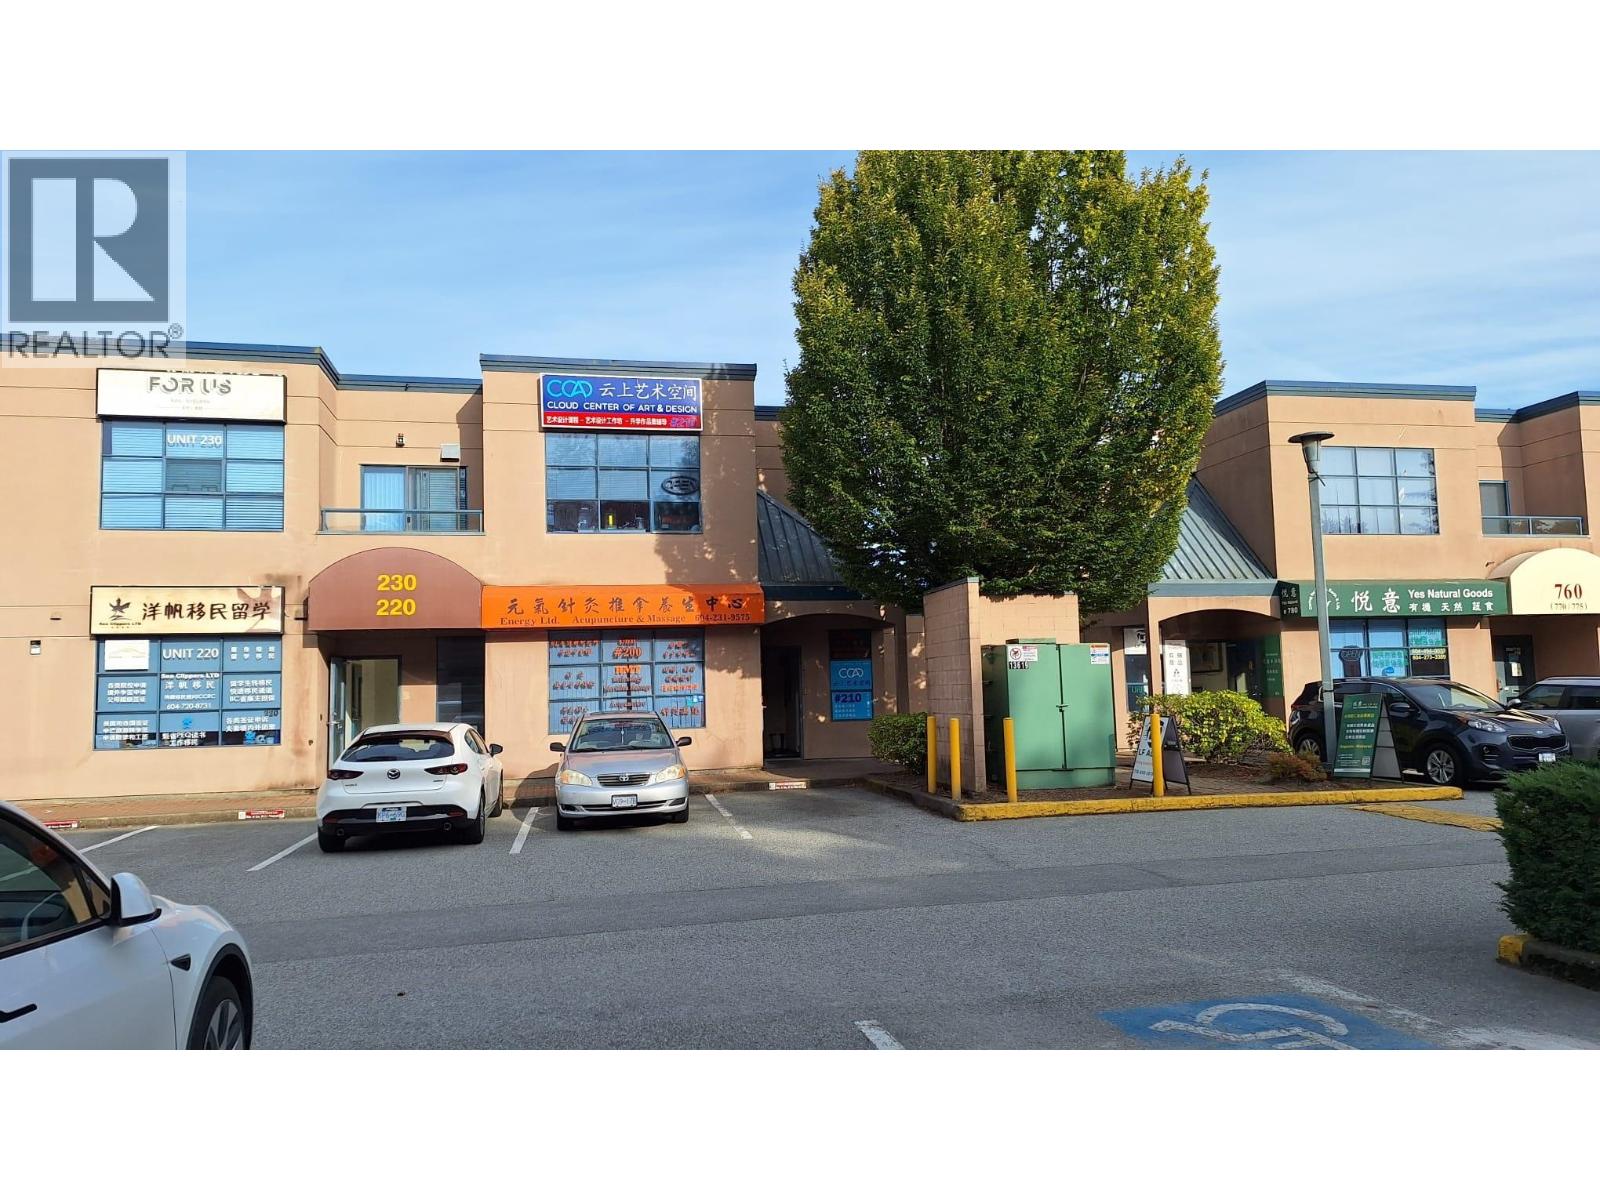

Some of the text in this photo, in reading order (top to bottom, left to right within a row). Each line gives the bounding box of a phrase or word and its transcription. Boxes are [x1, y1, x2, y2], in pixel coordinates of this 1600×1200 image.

[149, 376, 232, 394] FOR US
[599, 381, 696, 401] 云上艺术空间
[547, 401, 697, 413] CLOUD CENTER OF ART & DESIGN
[167, 434, 223, 446] UNIT 230
[376, 574, 417, 591] 230
[1408, 588, 1493, 599] Yes Natural Goods
[1555, 583, 1583, 600] 760
[1351, 587, 1400, 613] 悦意
[142, 602, 271, 621] 洋帆移民留学
[376, 598, 416, 616] 220
[1441, 602, 1463, 612] 天然
[500, 617, 536, 626] Energy
[541, 616, 560, 625] Ltd.
[573, 615, 634, 625] Acupuncture
[637, 615, 645, 623] &
[648, 614, 686, 624] Massage
[163, 647, 194, 659] UNIT
[197, 647, 219, 659] 220
[614, 647, 642, 658] #200
[834, 693, 861, 703] #210
